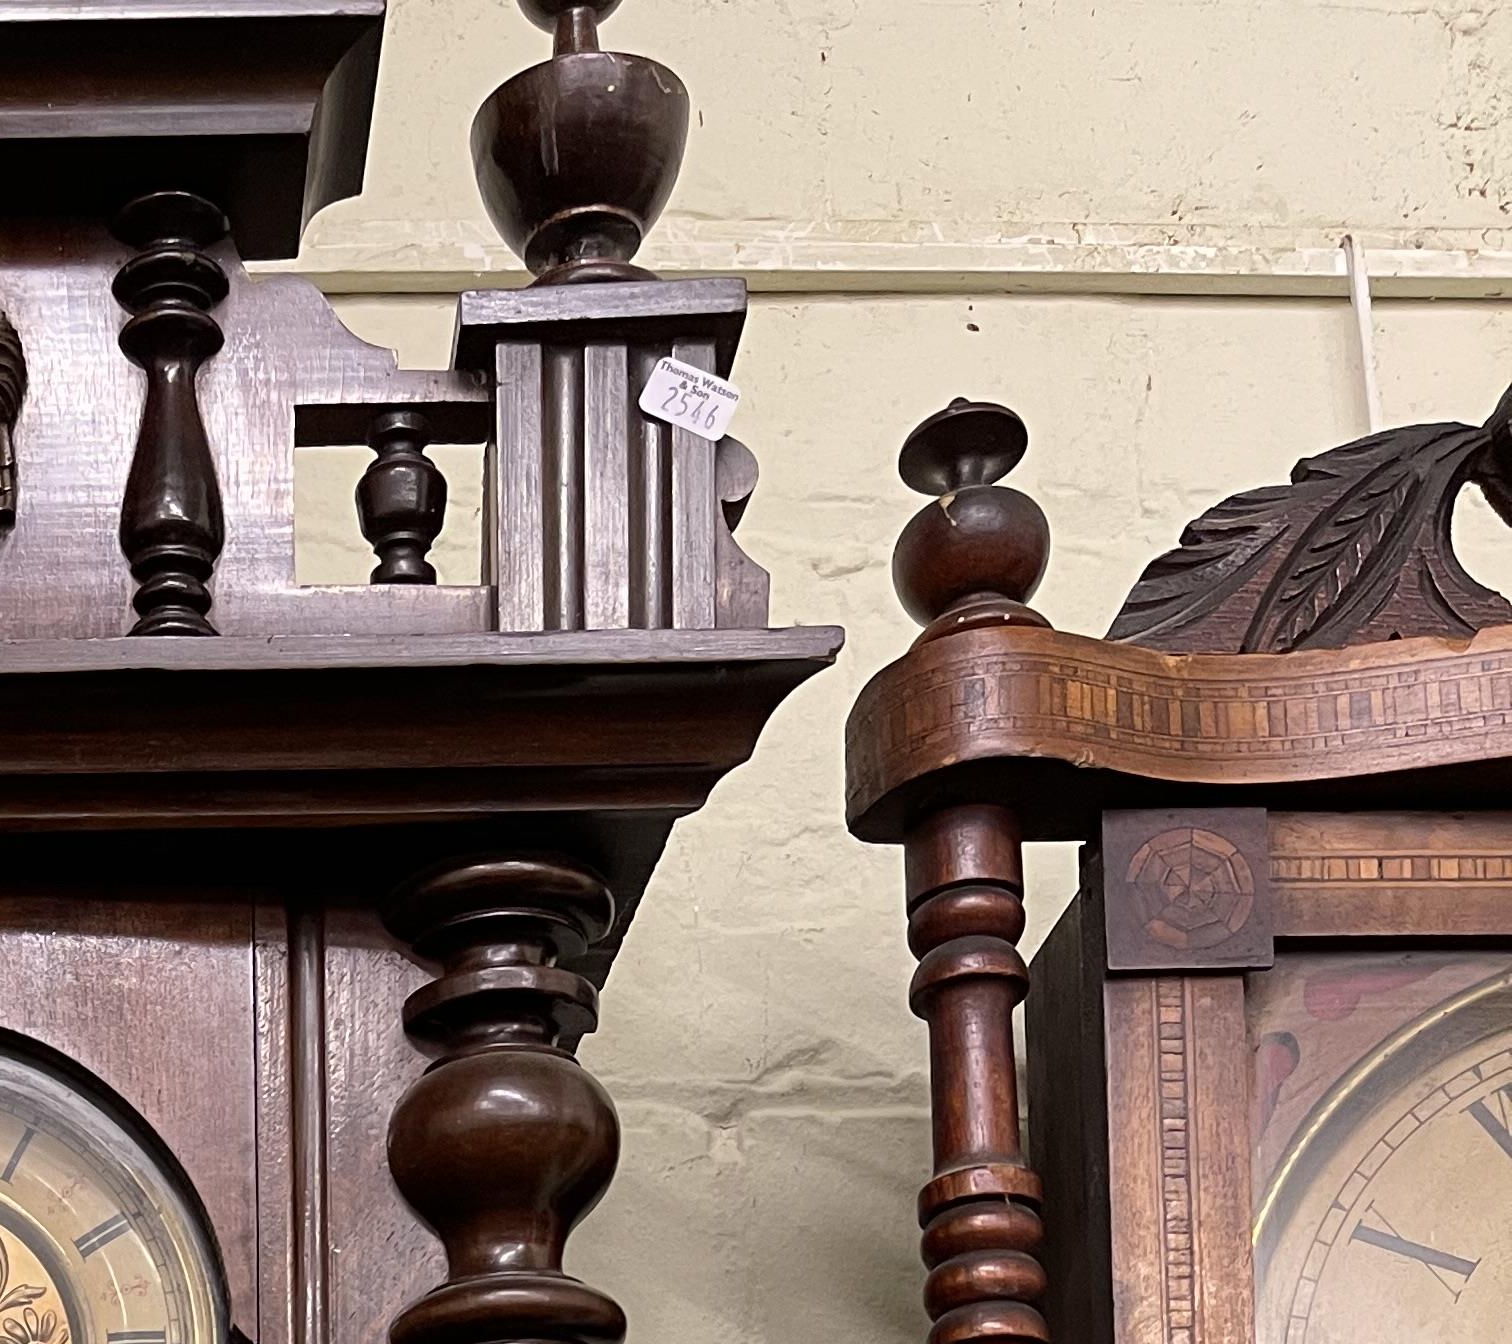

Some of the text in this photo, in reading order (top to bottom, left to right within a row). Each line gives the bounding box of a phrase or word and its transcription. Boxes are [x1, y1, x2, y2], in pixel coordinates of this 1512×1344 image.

[661, 360, 739, 402] Thomas Watson
[691, 385, 710, 400] Son
